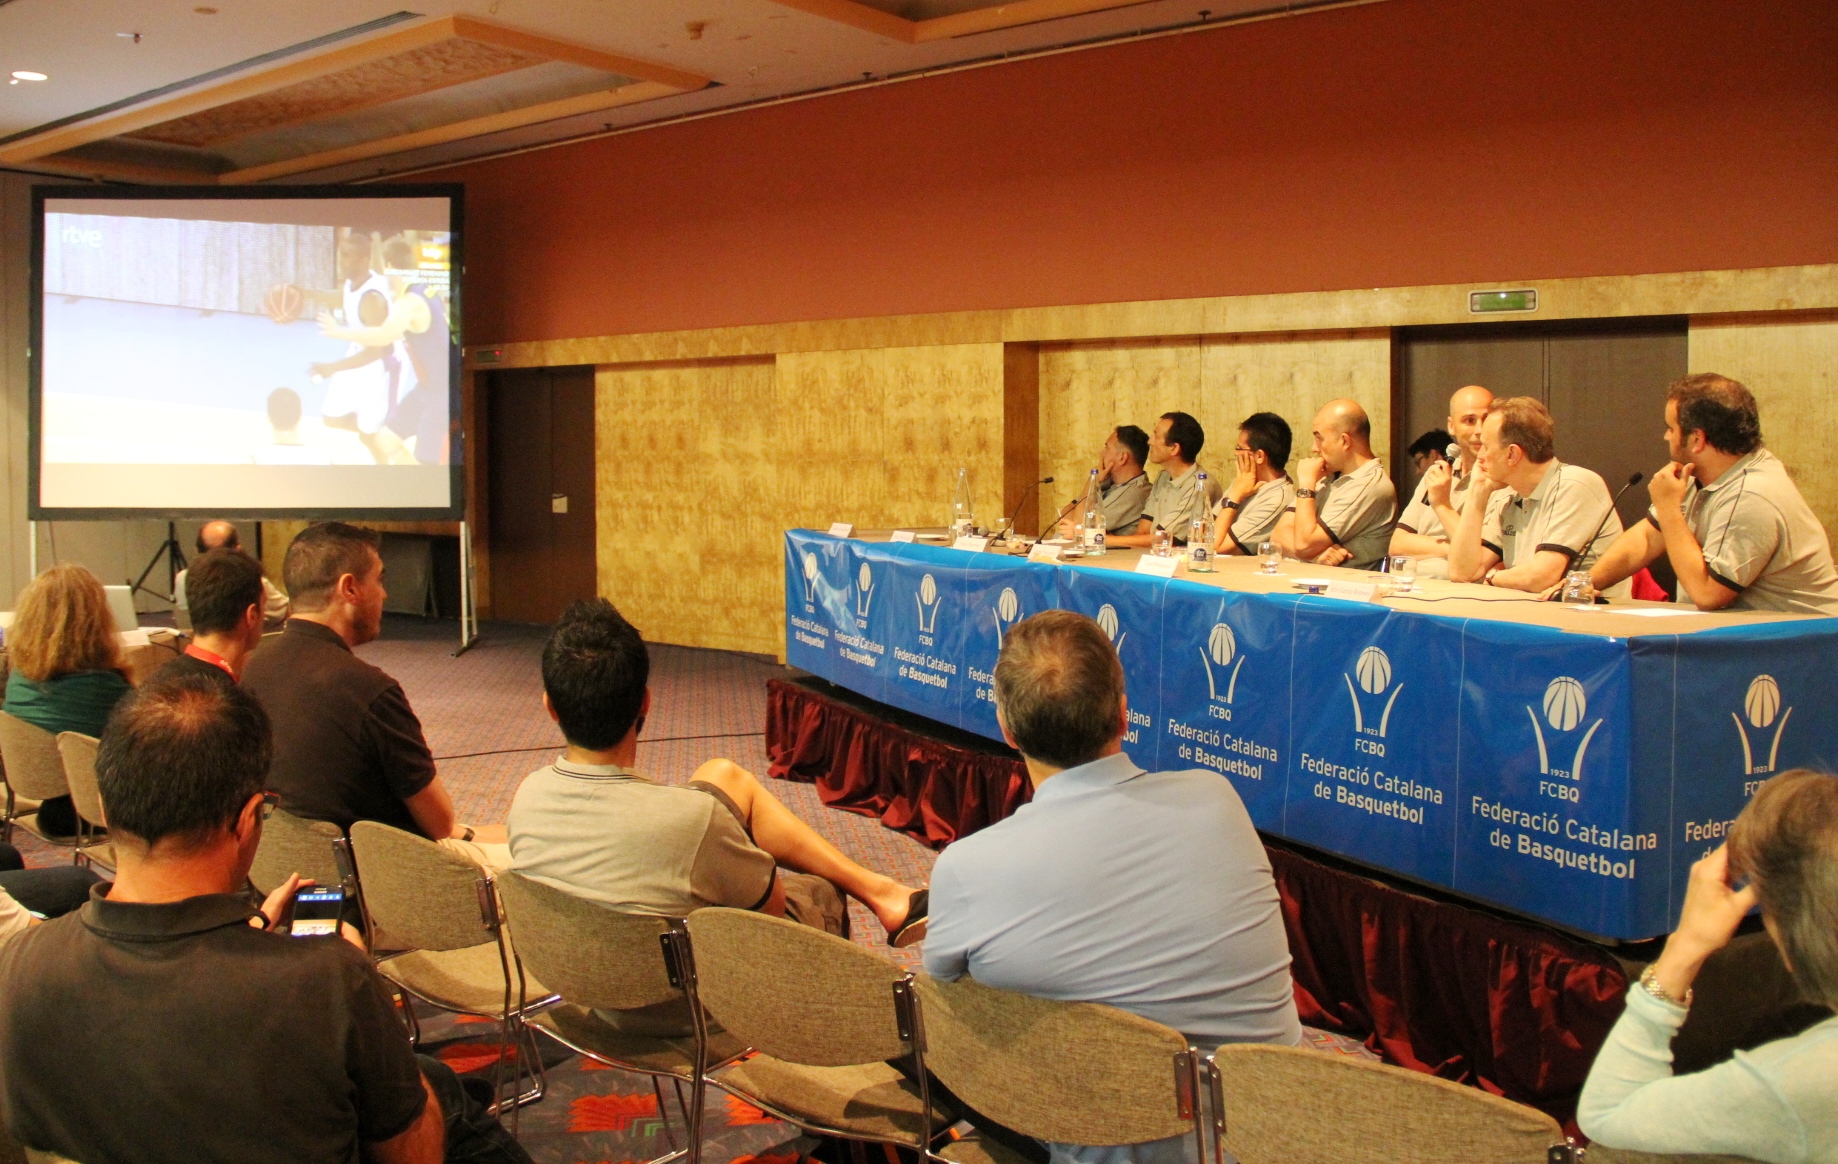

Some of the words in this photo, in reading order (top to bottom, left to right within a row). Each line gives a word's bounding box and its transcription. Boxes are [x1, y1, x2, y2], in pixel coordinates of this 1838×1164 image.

[63, 226, 102, 248] rtve
[834, 630, 860, 647] Federació
[860, 638, 884, 655] Catalana
[918, 635, 933, 646] FCBQ
[840, 647, 846, 657] de
[846, 648, 877, 667] Basquetbol
[894, 647, 926, 666] Federació
[926, 656, 957, 675] Catalana
[899, 665, 908, 677] de
[908, 667, 948, 689] Basquetbol
[968, 667, 995, 685] Federa
[976, 687, 986, 700] de
[1126, 708, 1151, 728] alana
[1208, 705, 1232, 721] FCBQ
[1168, 719, 1220, 747] Federació
[1223, 734, 1278, 762] Catalana
[1363, 727, 1379, 736] 1923
[1355, 739, 1386, 758] FCBQ
[1178, 744, 1192, 760] de
[1195, 747, 1262, 781] Basquetbol
[1753, 765, 1768, 774] 1923
[1301, 753, 1370, 786] Federació
[1374, 771, 1443, 805] Catalana
[1550, 769, 1570, 779] 1923
[1314, 781, 1332, 800] de
[1336, 786, 1424, 825] Basquetbol
[1540, 781, 1580, 803] FCBQ
[1472, 796, 1560, 835] Federació
[1565, 819, 1658, 851] Catalana
[1685, 819, 1735, 842] Feder
[1490, 829, 1512, 850] de
[1517, 834, 1636, 879] Basquetbol
